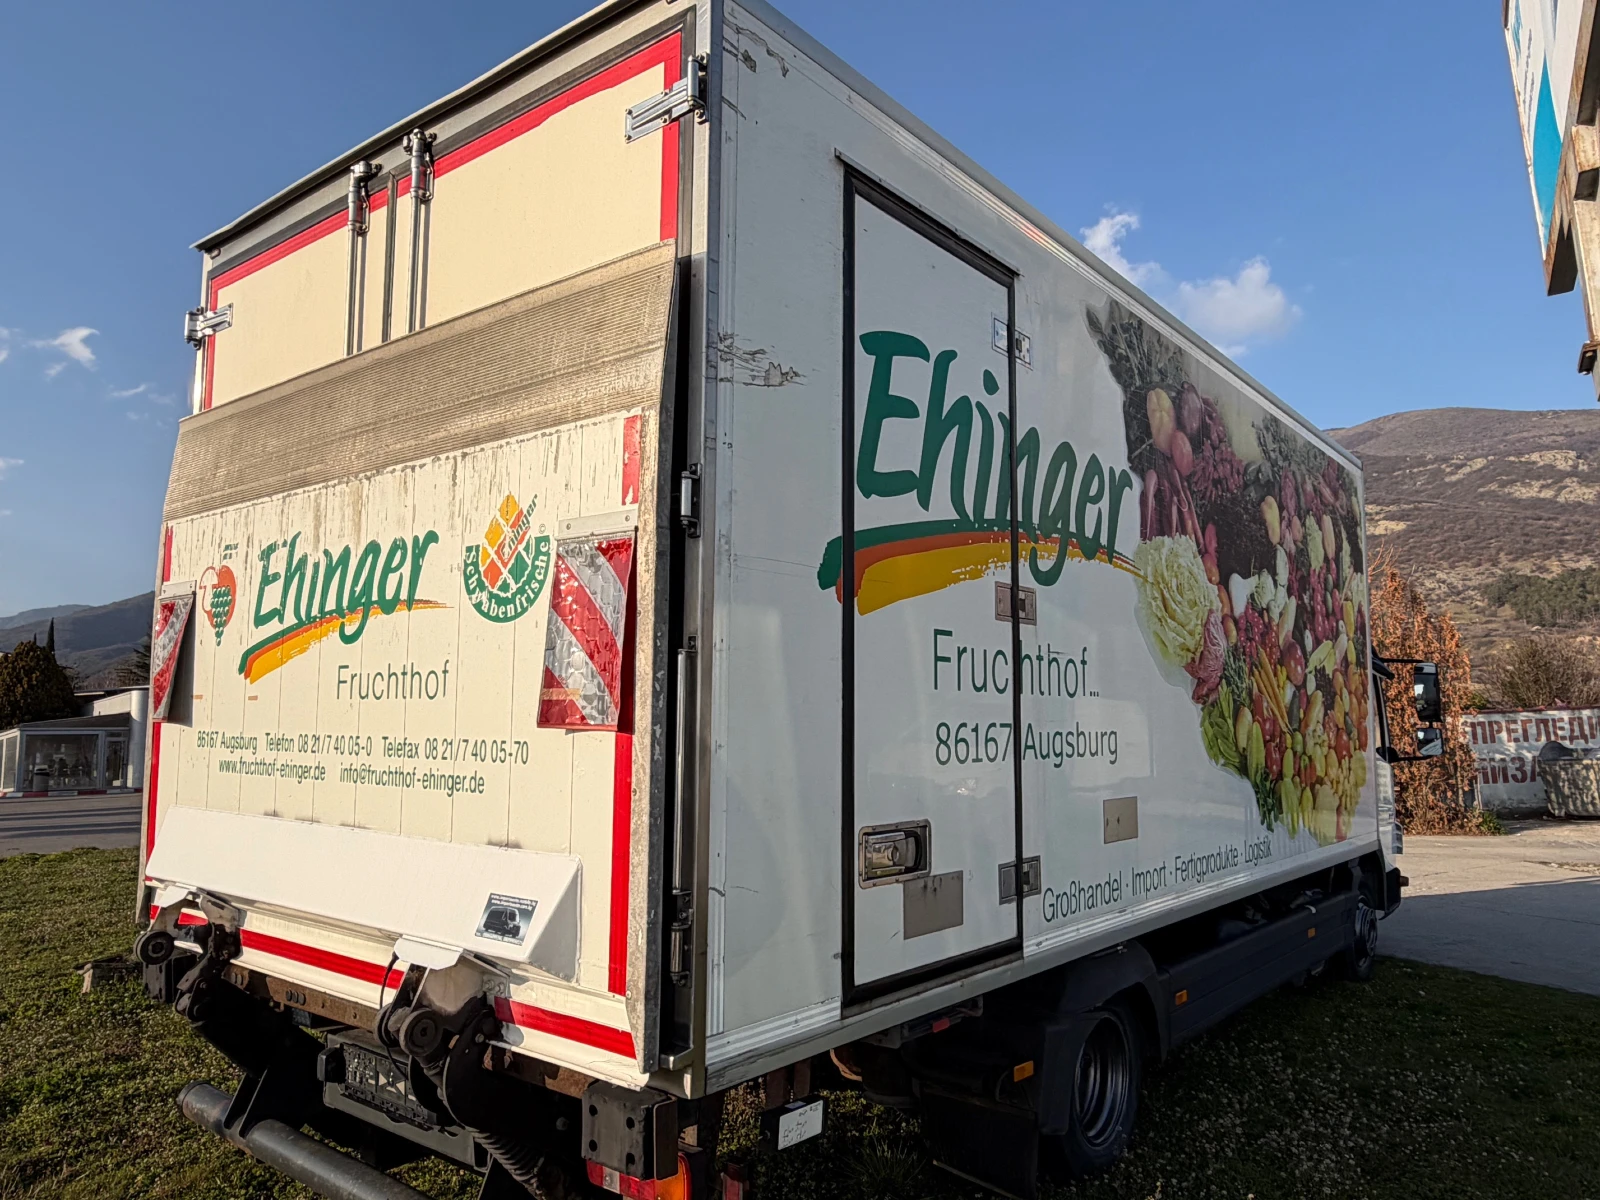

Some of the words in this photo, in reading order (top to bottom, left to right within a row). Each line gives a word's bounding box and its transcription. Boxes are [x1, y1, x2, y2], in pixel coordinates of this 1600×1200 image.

[856, 331, 1133, 586] Ehinger
[254, 530, 440, 645] Ehinger
[336, 659, 449, 701] Fruchthof
[196, 730, 219, 749] 86167
[219, 731, 258, 755] Augsburg
[264, 732, 295, 753] Telefon
[297, 733, 309, 754] 08
[333, 735, 346, 756] 40
[347, 735, 373, 757] 05-0
[381, 736, 420, 759] Telefax
[424, 737, 438, 760] 08
[471, 739, 487, 763] 40
[490, 740, 530, 765] 05-70
[935, 722, 1013, 766] 86167
[1022, 721, 1118, 768] Augsburg
[218, 755, 326, 785] www.fruchthof-ehinger.de
[339, 762, 485, 798] info@fruchthof-ehinger.de
[1042, 870, 1123, 923] Großhandel
[1131, 860, 1167, 900] Import
[1174, 845, 1240, 883] Fertigprodukte
[1243, 834, 1273, 867] Logistik
